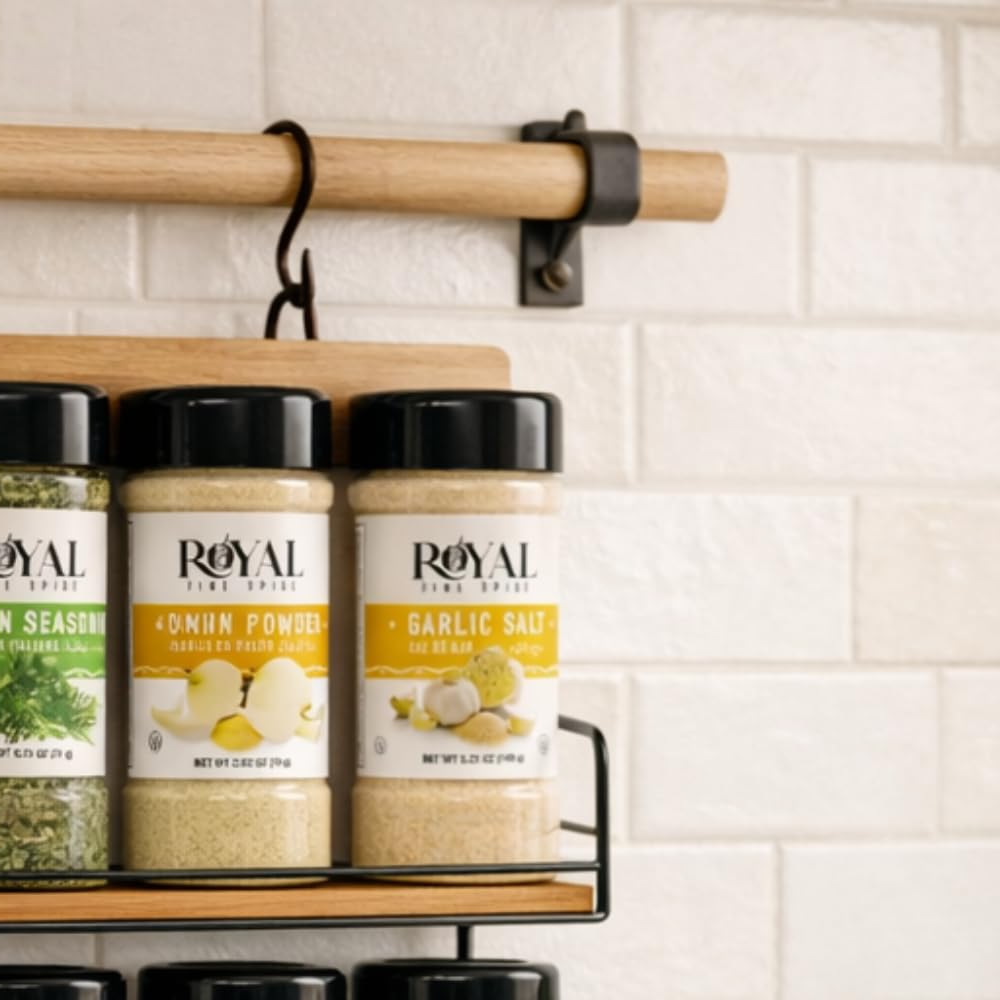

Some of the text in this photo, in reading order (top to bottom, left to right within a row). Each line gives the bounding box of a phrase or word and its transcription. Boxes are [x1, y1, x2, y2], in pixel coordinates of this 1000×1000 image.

[178, 533, 303, 578] ROYAL
[413, 536, 538, 580] ROYAL
[407, 611, 545, 636] GARLIC SALT
